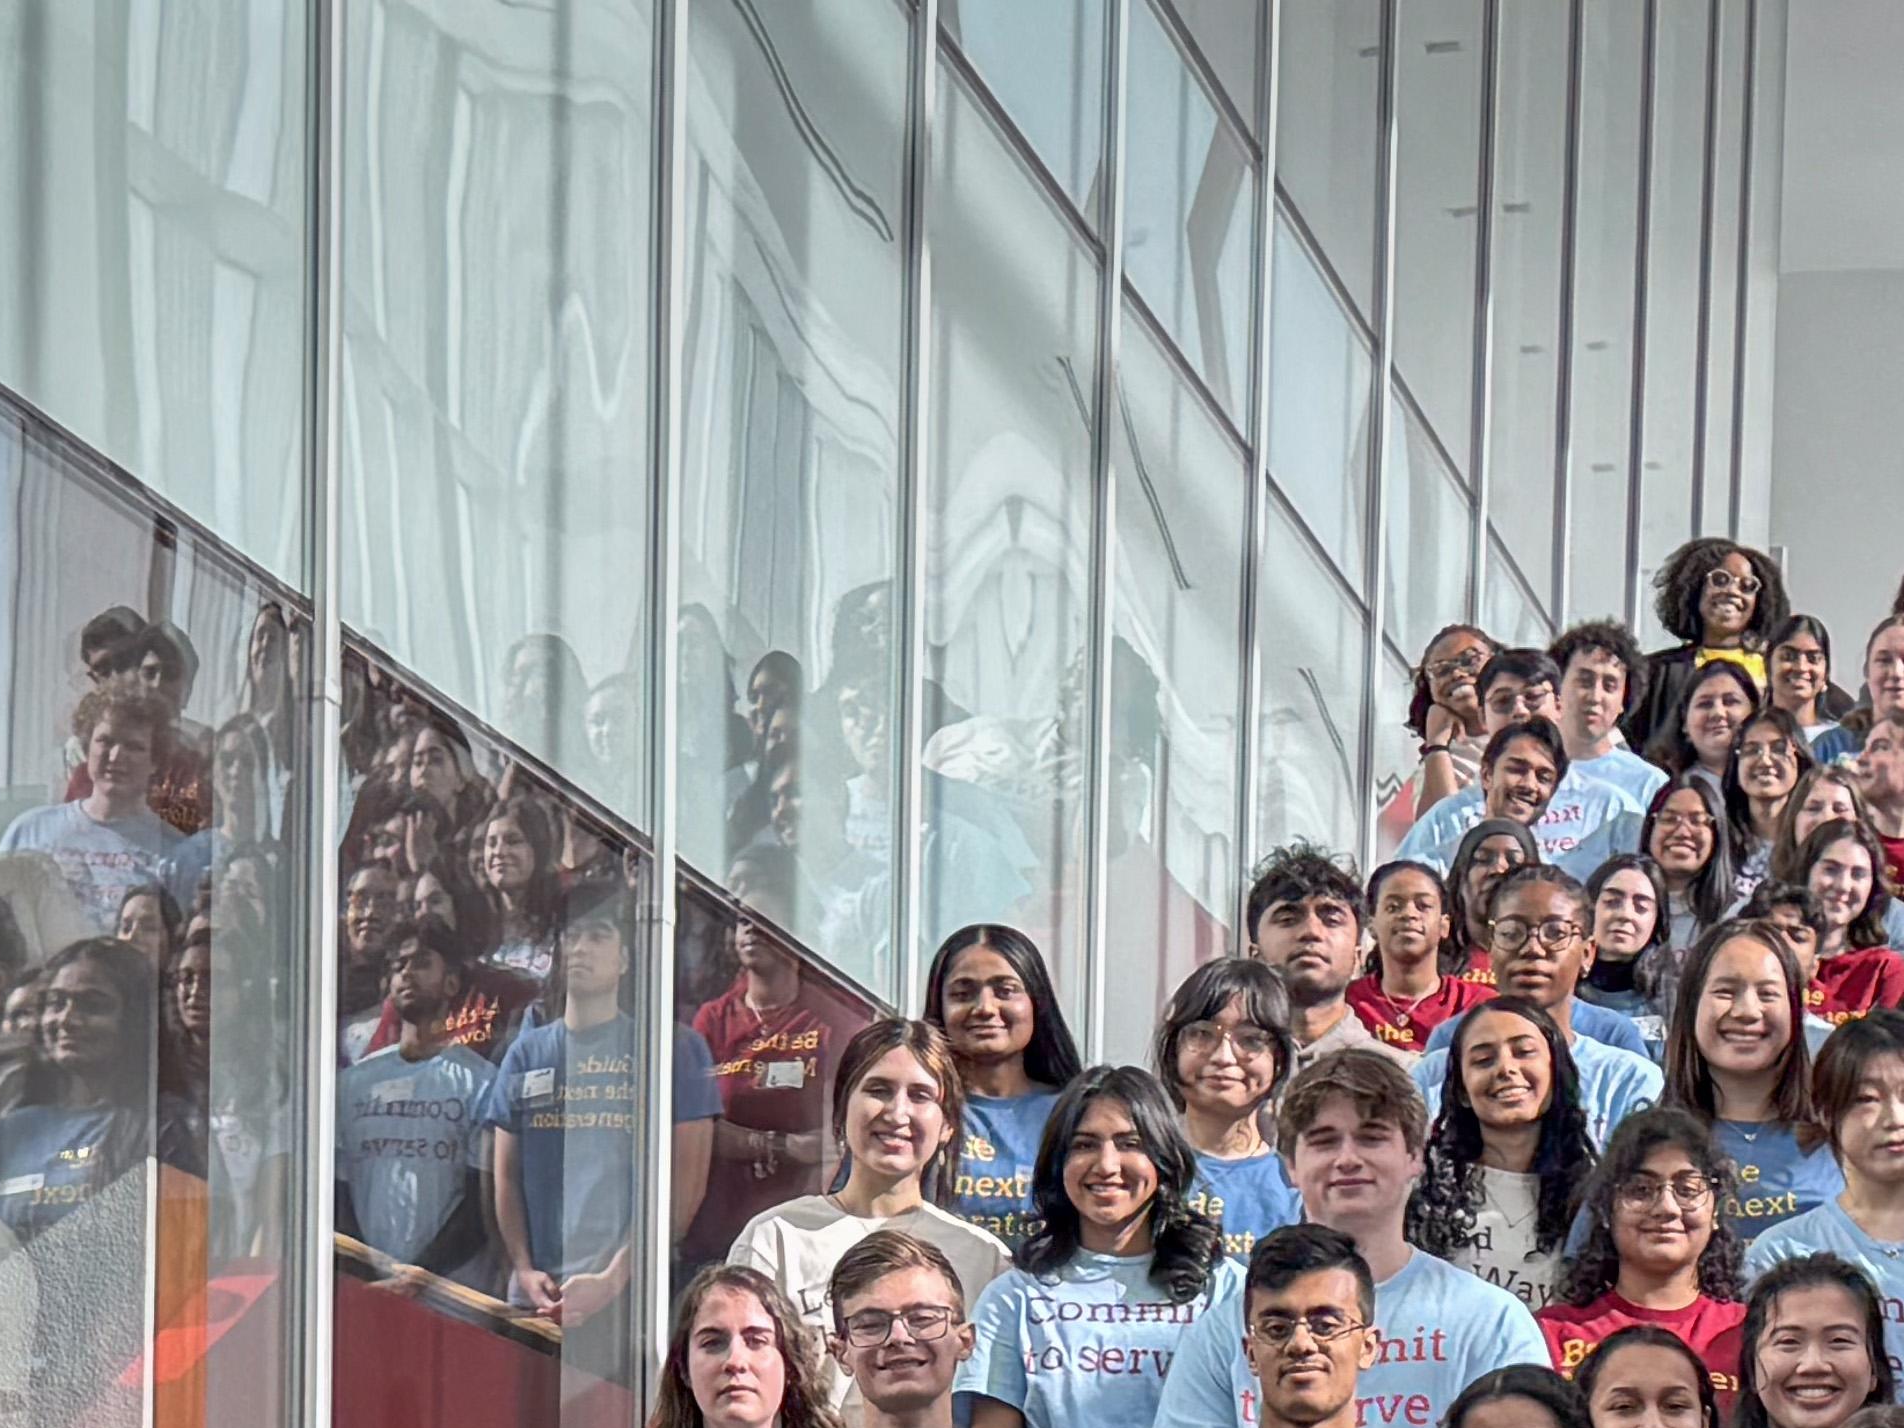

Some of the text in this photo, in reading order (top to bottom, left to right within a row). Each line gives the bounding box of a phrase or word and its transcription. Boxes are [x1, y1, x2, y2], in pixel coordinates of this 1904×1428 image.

[955, 1174, 1027, 1197] next
[1024, 1344, 1171, 1376] to serv
[1240, 1389, 1256, 1422] t
